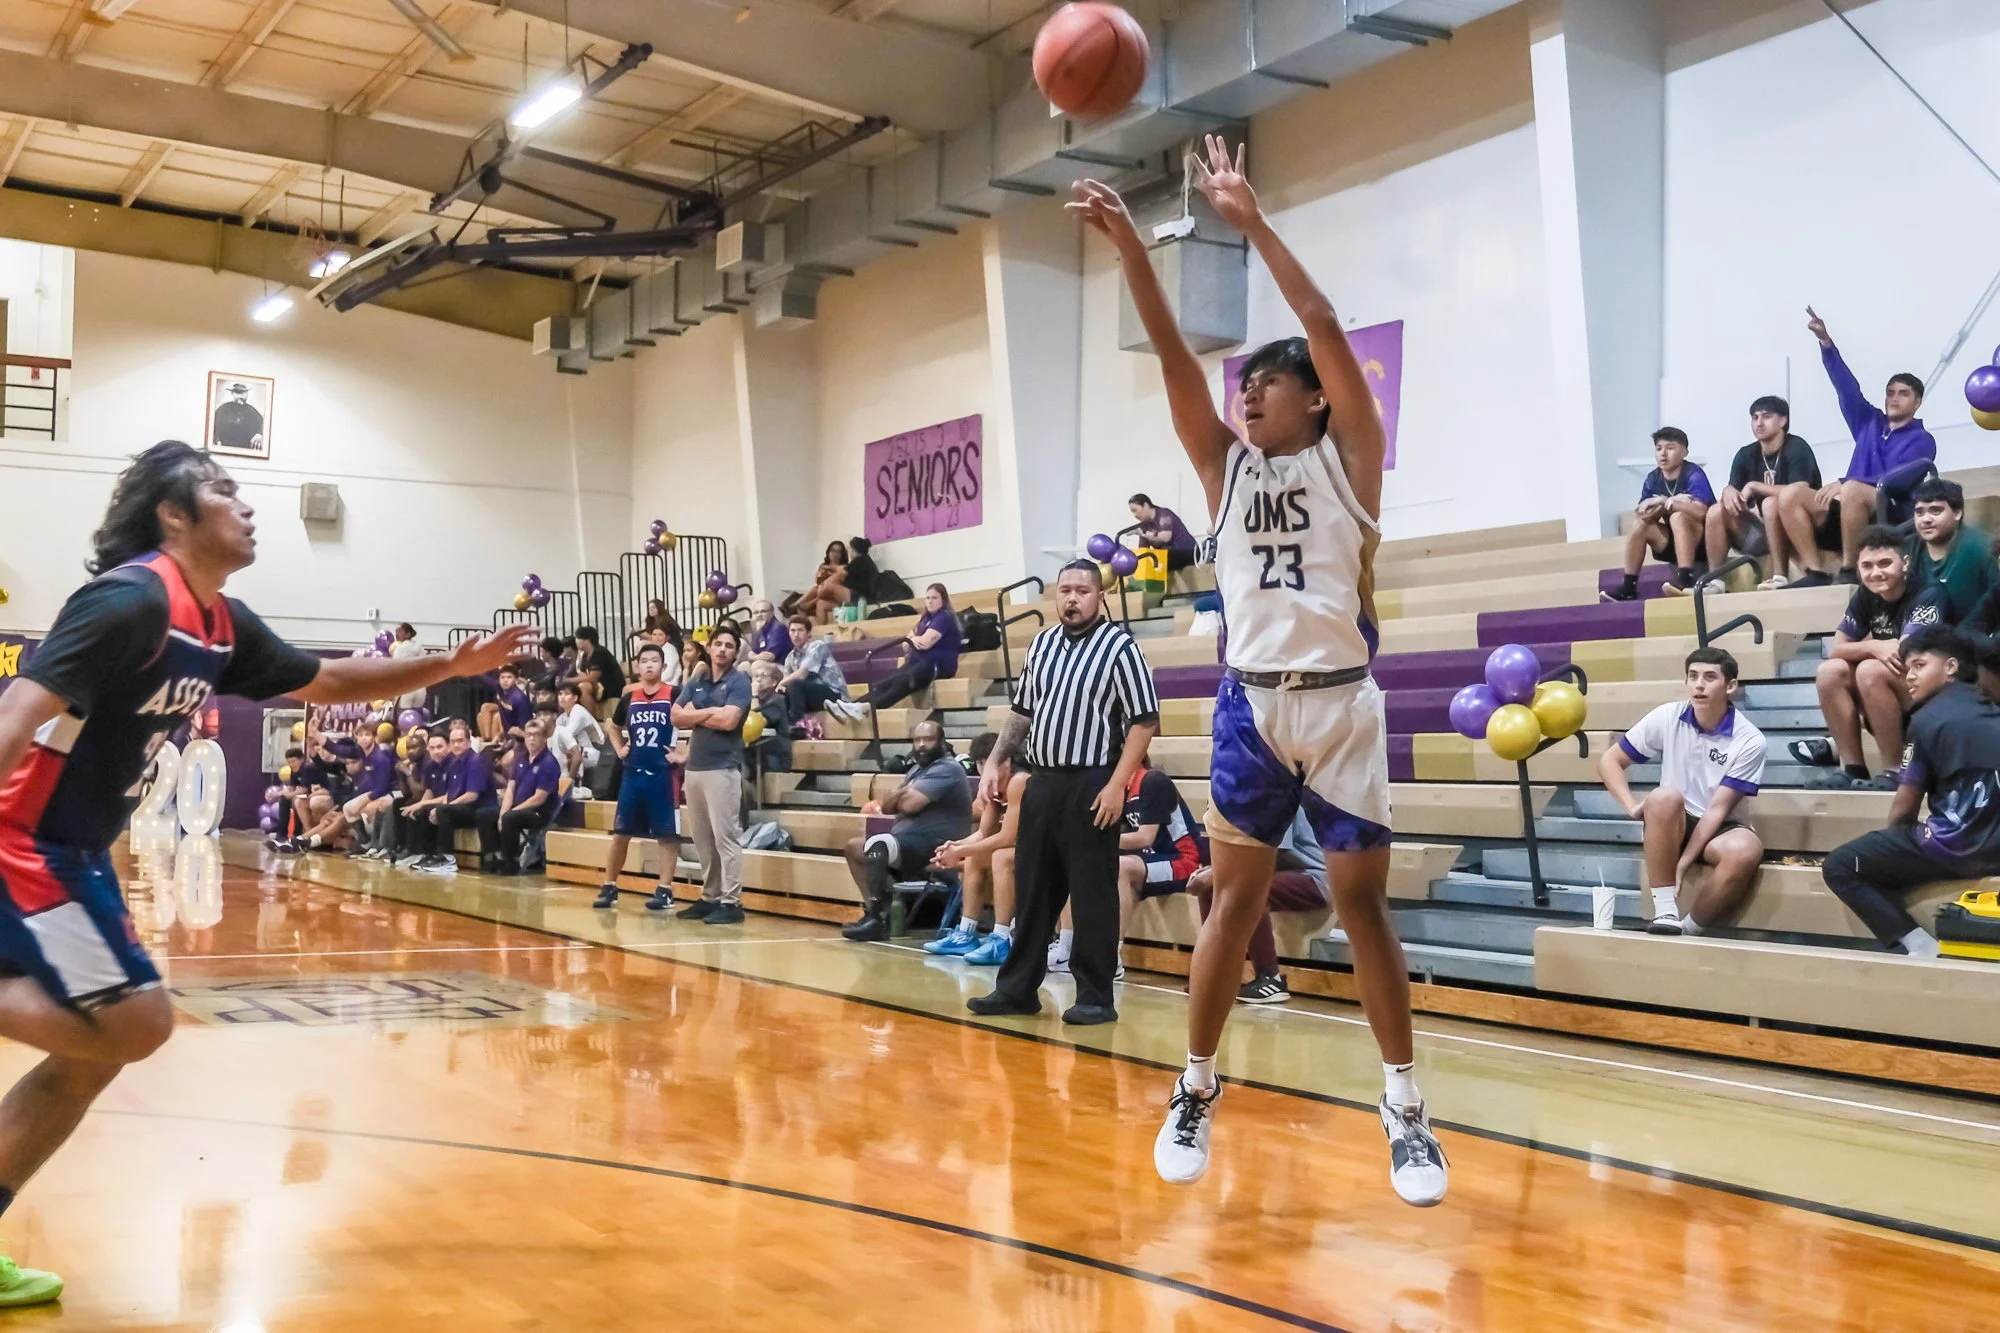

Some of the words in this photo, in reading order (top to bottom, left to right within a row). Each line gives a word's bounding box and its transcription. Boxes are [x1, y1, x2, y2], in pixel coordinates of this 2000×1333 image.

[876, 440, 980, 520] SENIORS
[1251, 543, 1305, 591] 23
[630, 710, 667, 726] ASSETS
[635, 727, 659, 748] 32
